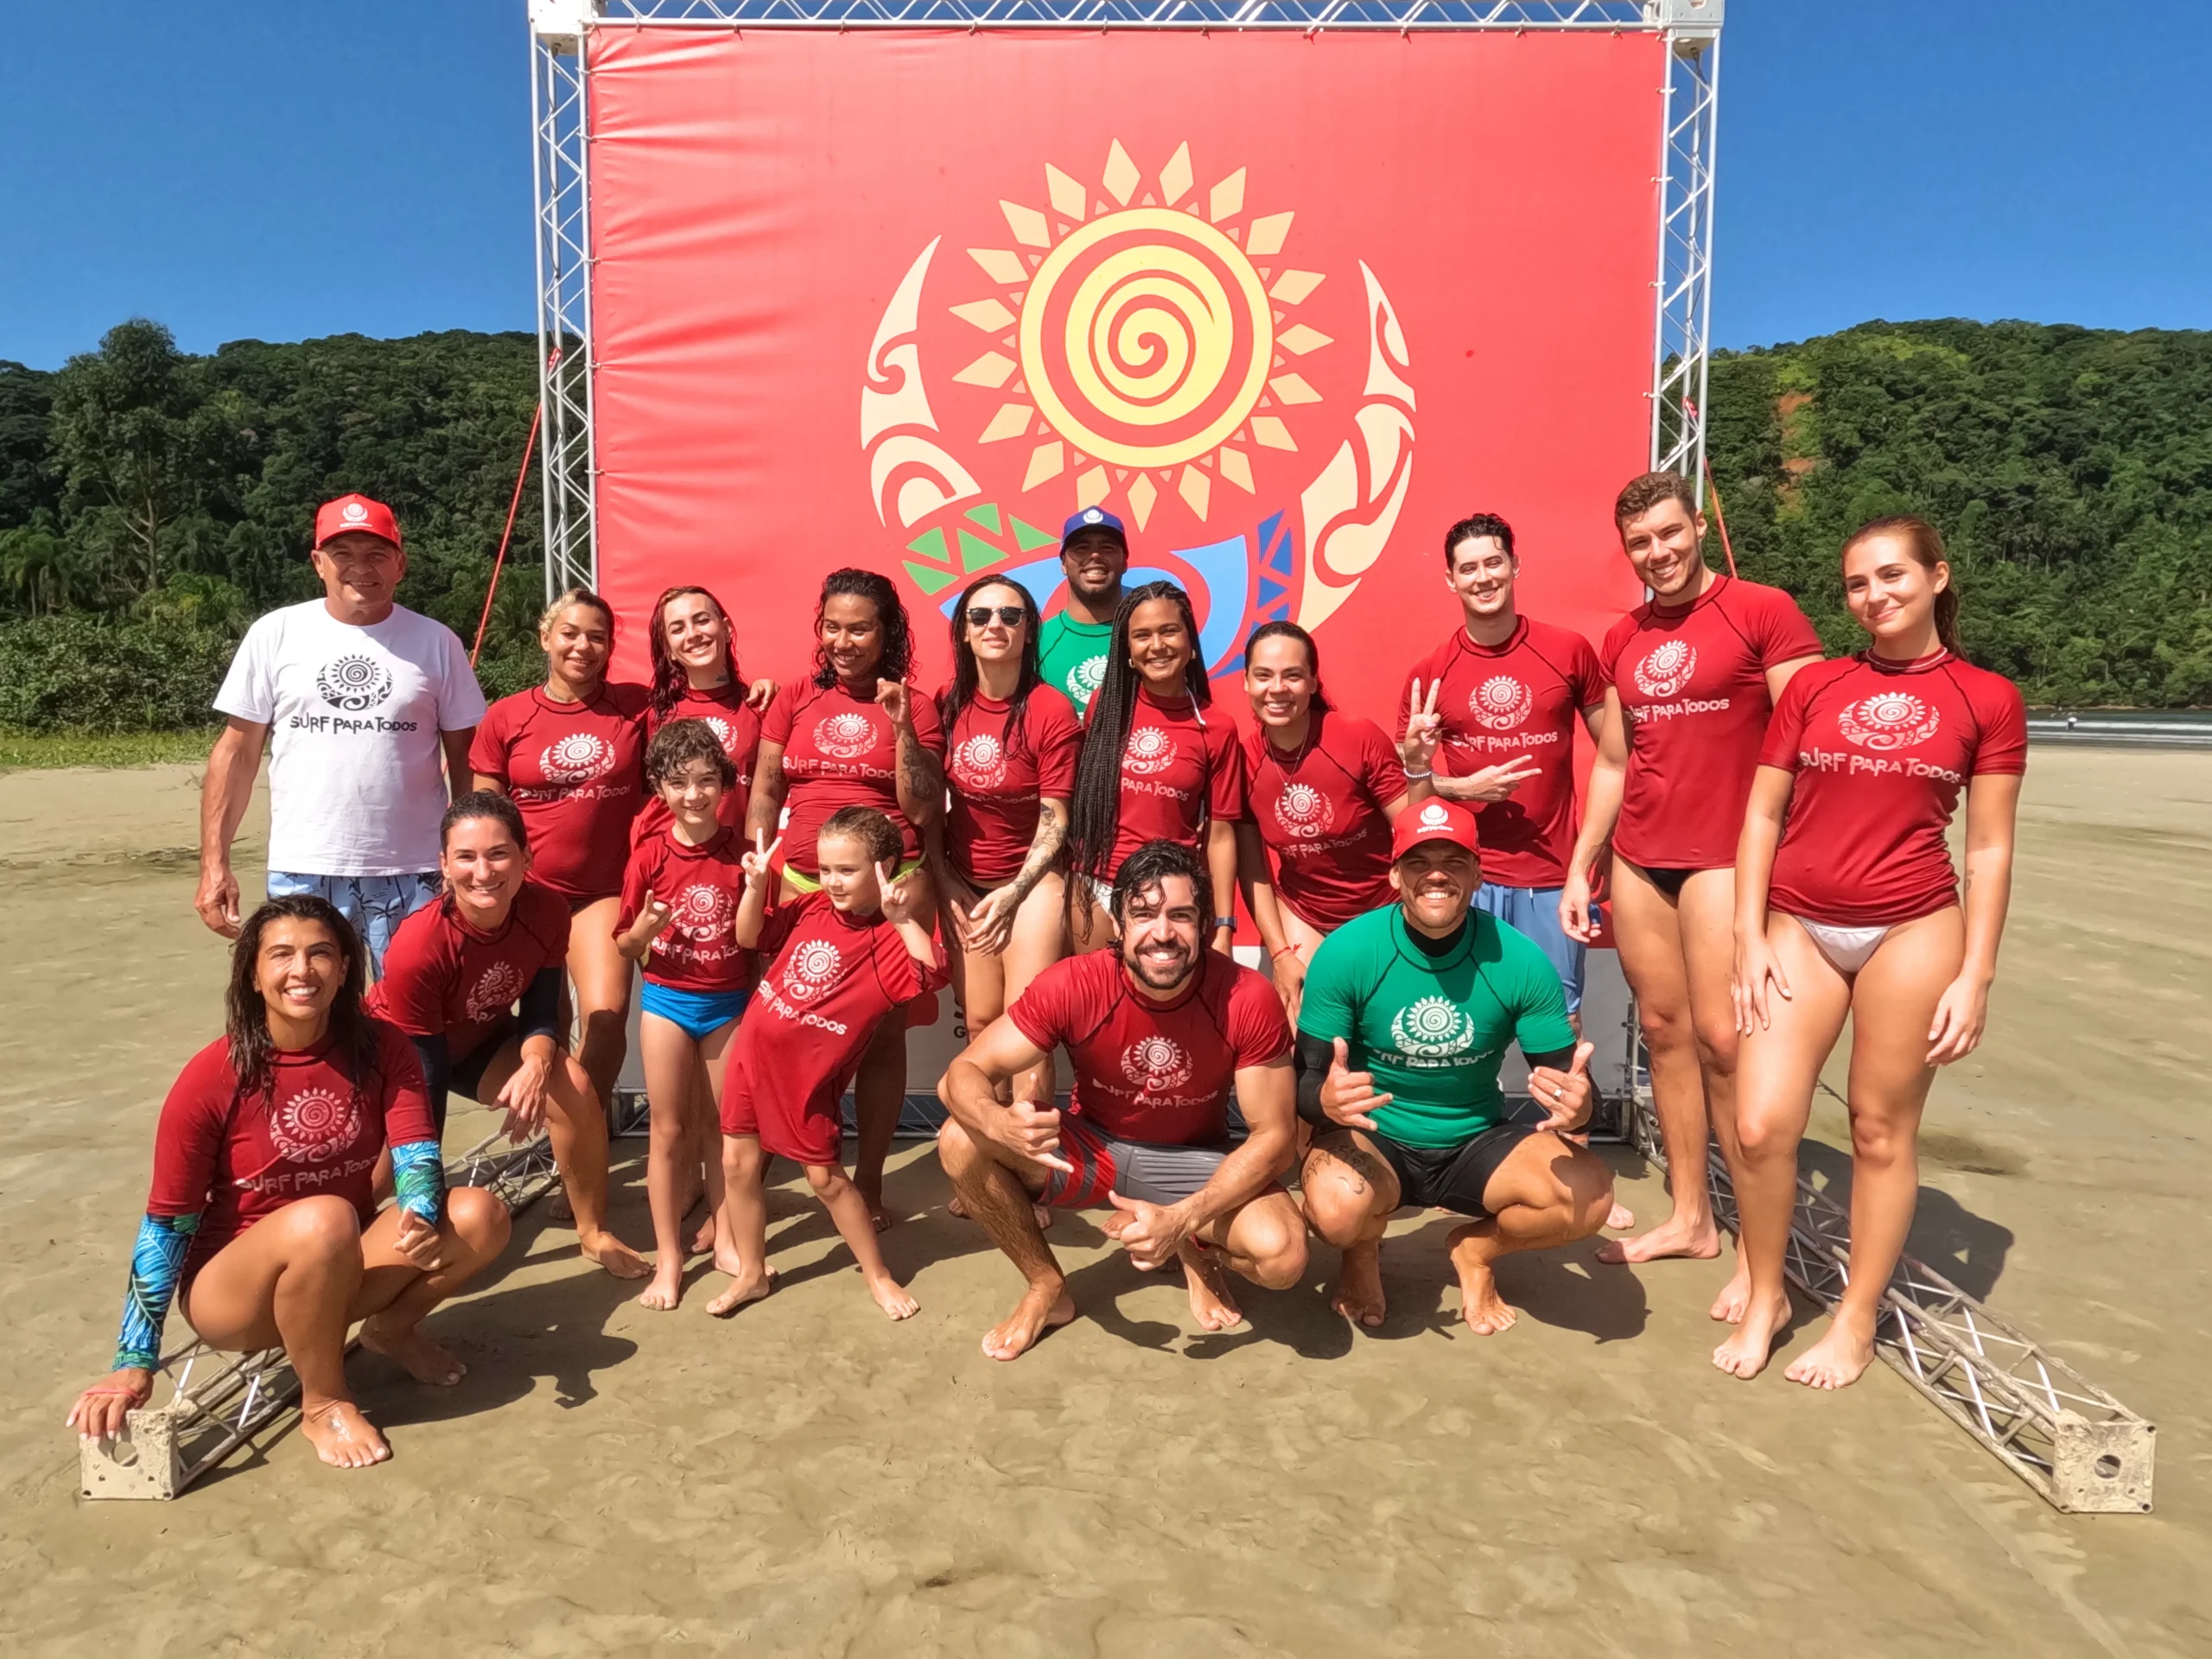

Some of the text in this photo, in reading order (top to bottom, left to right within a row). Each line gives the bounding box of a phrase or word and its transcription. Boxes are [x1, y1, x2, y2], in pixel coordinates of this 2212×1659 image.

[1651, 702, 1684, 722] PARA
[1681, 698, 1730, 715] TODOS
[290, 712, 418, 734] SURF PARA TODOS
[1487, 736, 1521, 753] PARA
[1519, 731, 1558, 748] TODOS
[782, 755, 819, 774] SURF
[859, 763, 896, 779] TODO
[1799, 747, 1961, 784] SURF PARA TODOS
[1121, 777, 1190, 801] PARA TODOS
[1329, 828, 1368, 849] TODOS
[682, 947, 721, 965] PARA
[1133, 1090, 1173, 1109] PARA
[295, 1166, 341, 1192] PARA
